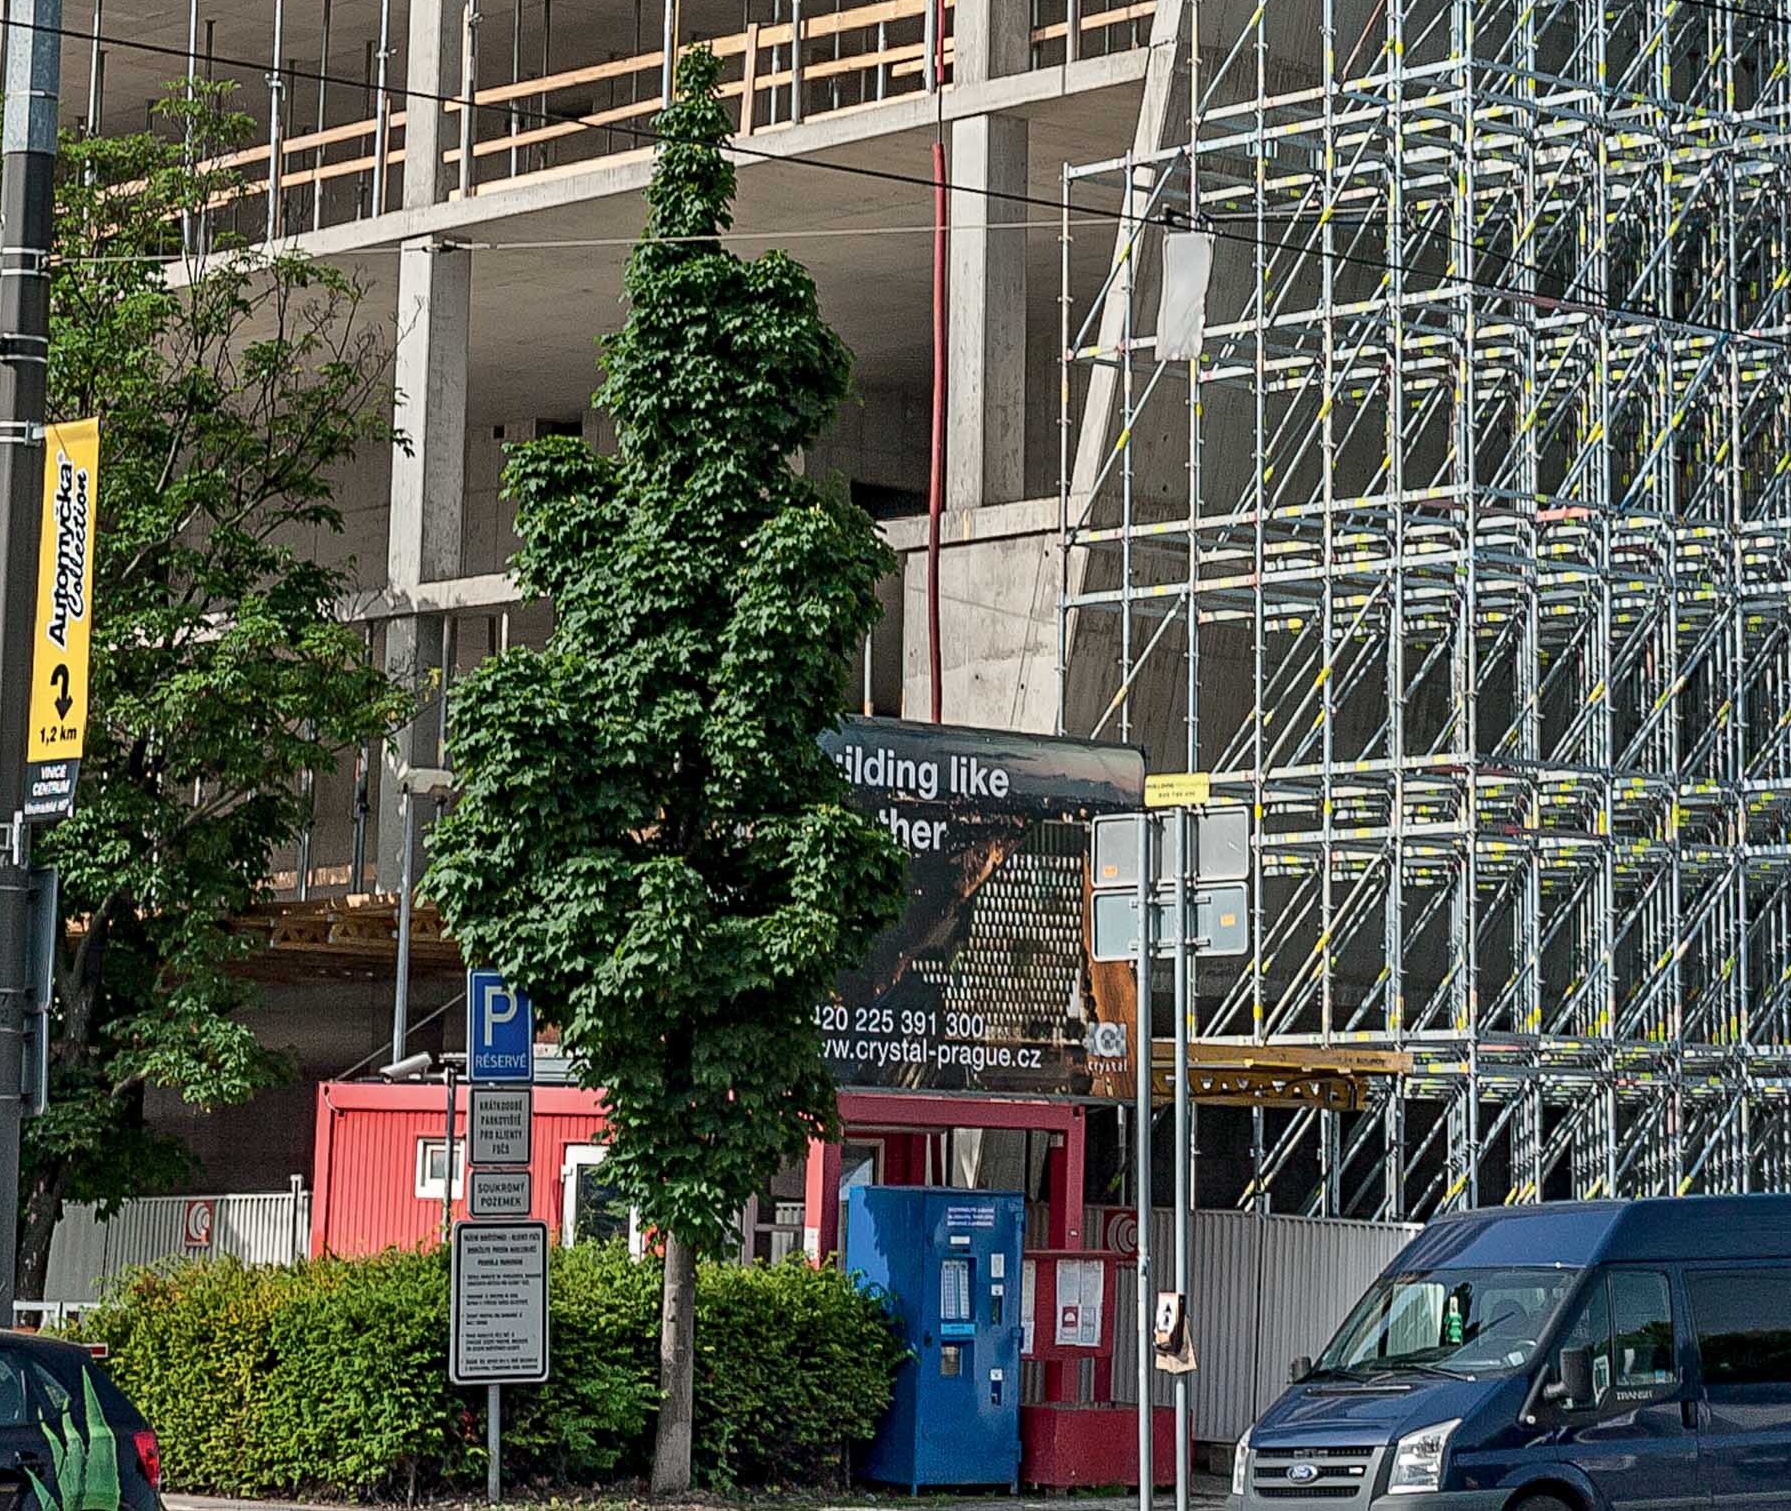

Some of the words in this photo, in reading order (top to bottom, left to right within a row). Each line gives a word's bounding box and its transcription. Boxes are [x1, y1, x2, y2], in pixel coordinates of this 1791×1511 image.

[49, 463, 73, 647] Automyčka
[68, 470, 87, 618] Collection
[40, 726, 57, 744] 1,2
[59, 725, 78, 741] km
[835, 745, 938, 799] ilding
[950, 755, 1009, 798] like
[484, 985, 517, 1046] P
[855, 1008, 894, 1034] 225
[900, 1010, 937, 1036] 391
[946, 1012, 984, 1038] 300
[475, 1053, 527, 1069] RÉSERVÉ
[480, 1128, 494, 1140] PRO
[477, 1181, 525, 1194] SOUKROMÝ
[480, 1195, 522, 1207] POZEMEK
